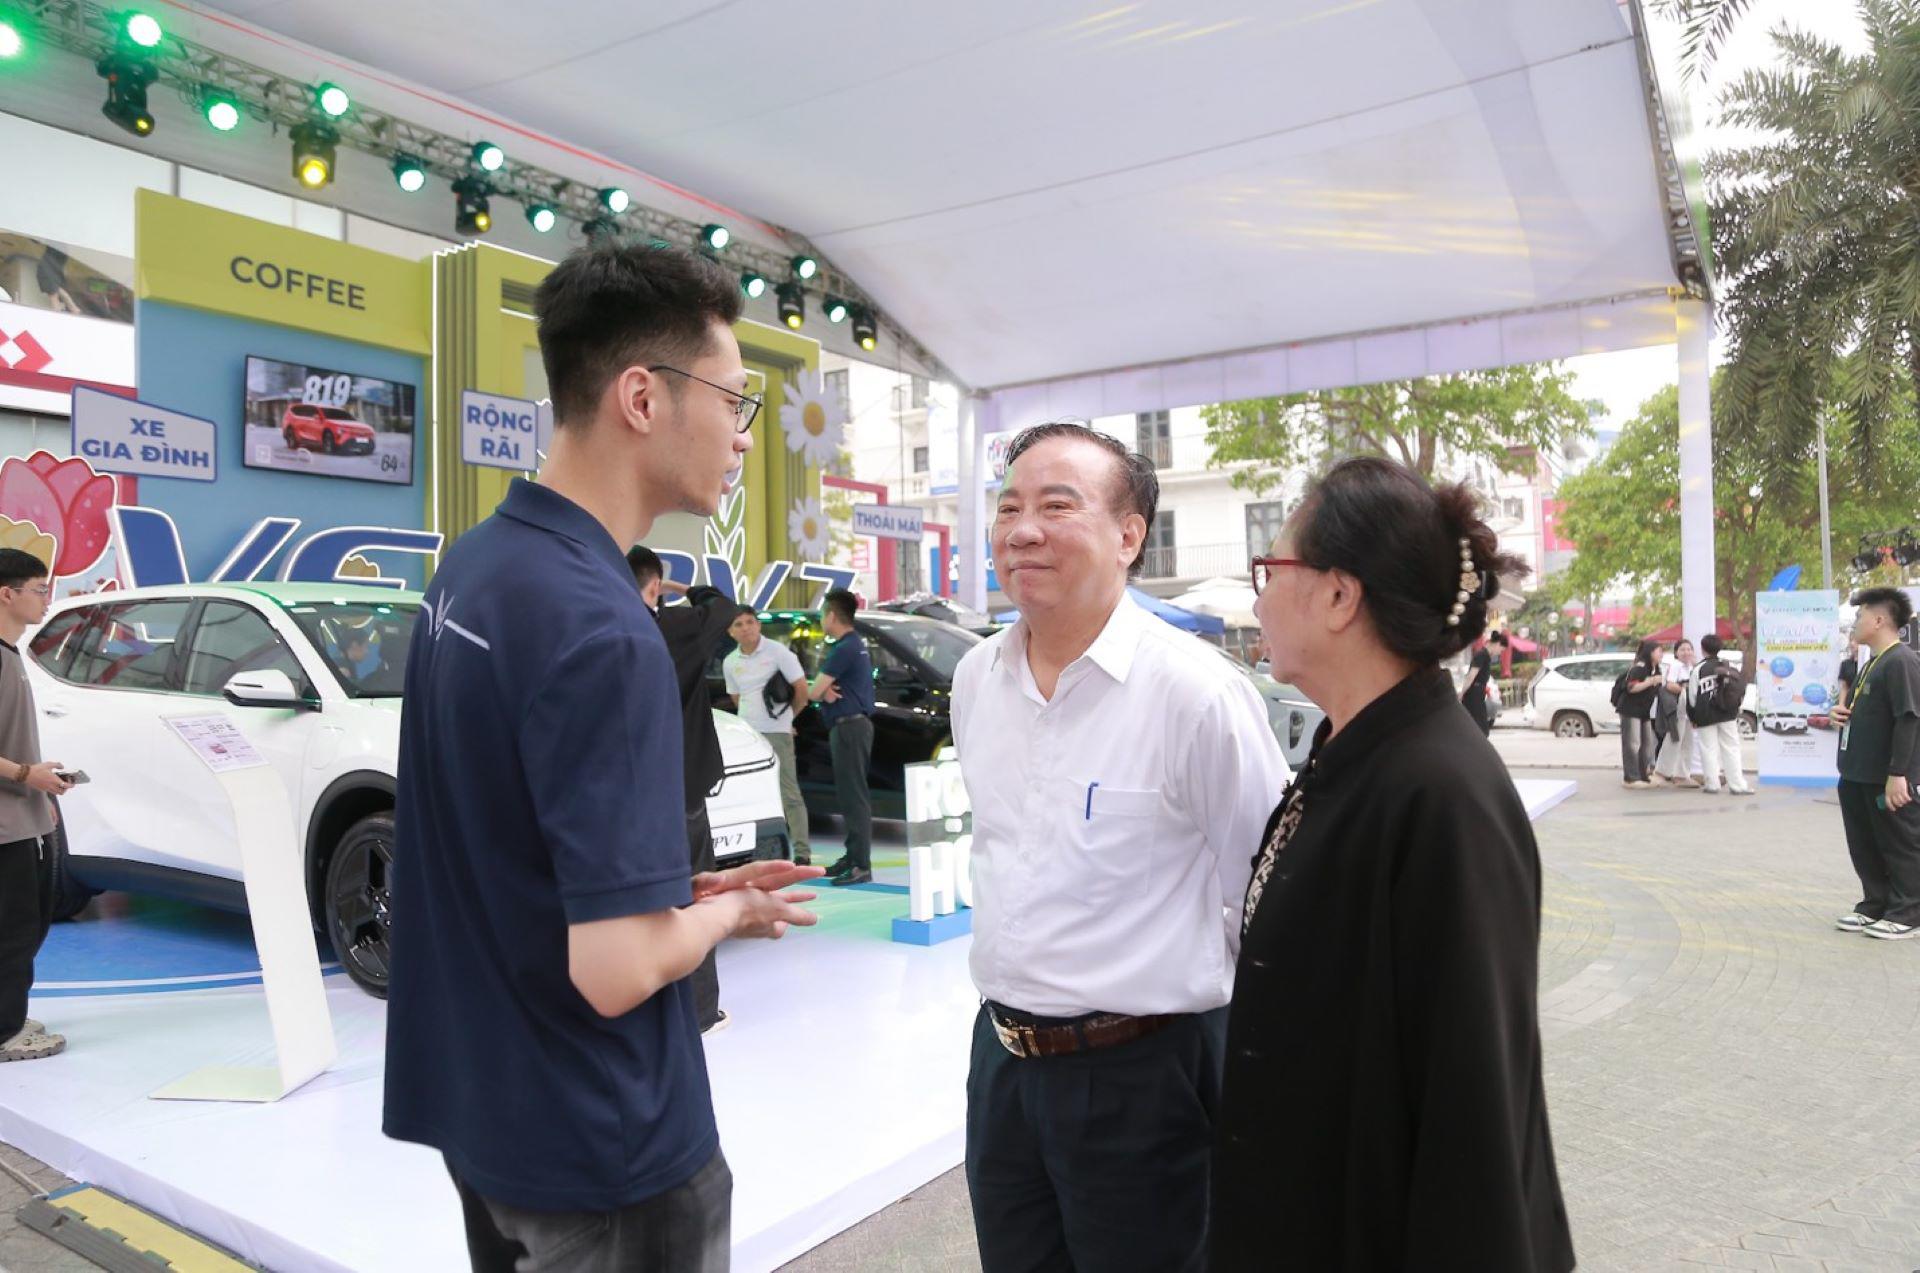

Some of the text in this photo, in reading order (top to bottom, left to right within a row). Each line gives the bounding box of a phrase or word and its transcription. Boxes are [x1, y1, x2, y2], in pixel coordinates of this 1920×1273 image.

[230, 255, 366, 311] COFFEE
[302, 375, 351, 407] 819
[130, 418, 165, 438] XE
[467, 403, 533, 433] RỘNG
[81, 439, 209, 468] GIA ĐÌNH
[481, 435, 520, 460] RÃI
[712, 834, 734, 849] PV
